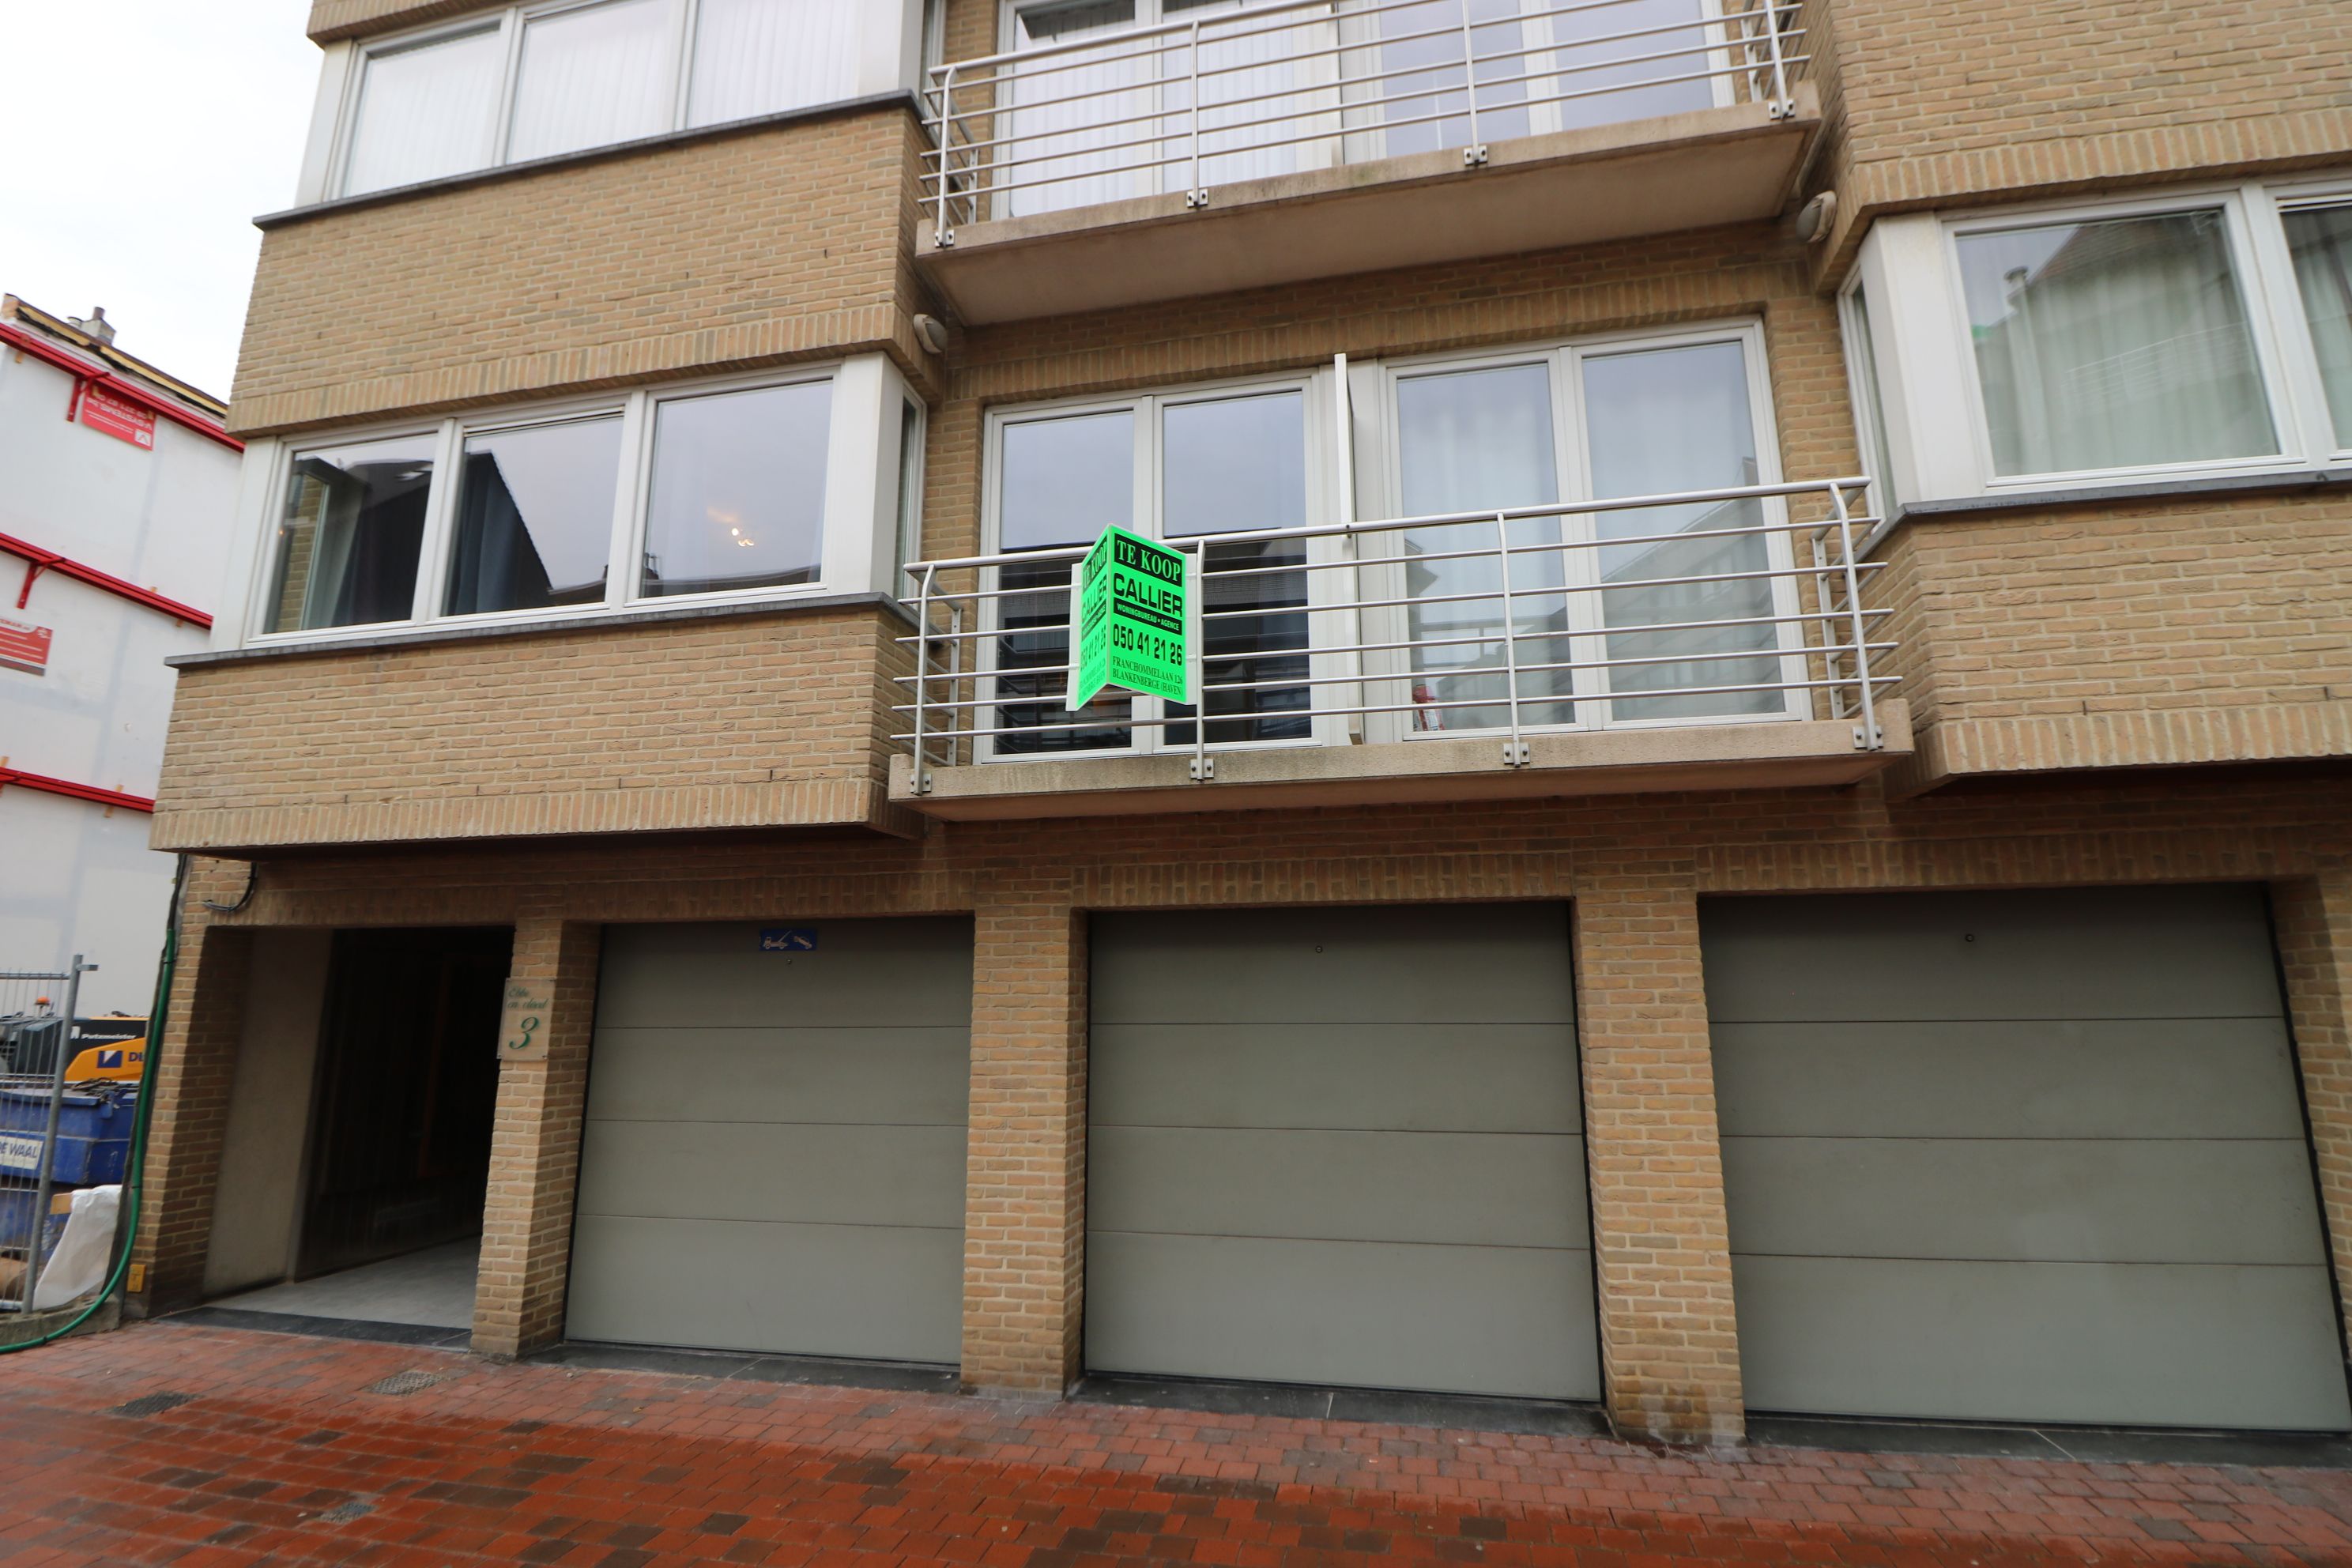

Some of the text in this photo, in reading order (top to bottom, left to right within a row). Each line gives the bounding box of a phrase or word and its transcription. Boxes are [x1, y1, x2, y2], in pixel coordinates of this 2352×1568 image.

[1117, 540, 1181, 582] TE KOOP
[1114, 572, 1182, 618] CALLIER
[1117, 602, 1157, 624] WONINGBUREAU
[1161, 618, 1180, 631] AGENCE
[1113, 624, 1182, 665] 050 41 21 26
[1113, 656, 1174, 681] FRANCHOMMELAAN
[1174, 674, 1183, 685] 126
[1113, 669, 1160, 690] BLANKENBERGE
[1161, 680, 1183, 697] (HAVEN)
[509, 1016, 540, 1050] 3
[9, 1143, 38, 1159] WAAL
